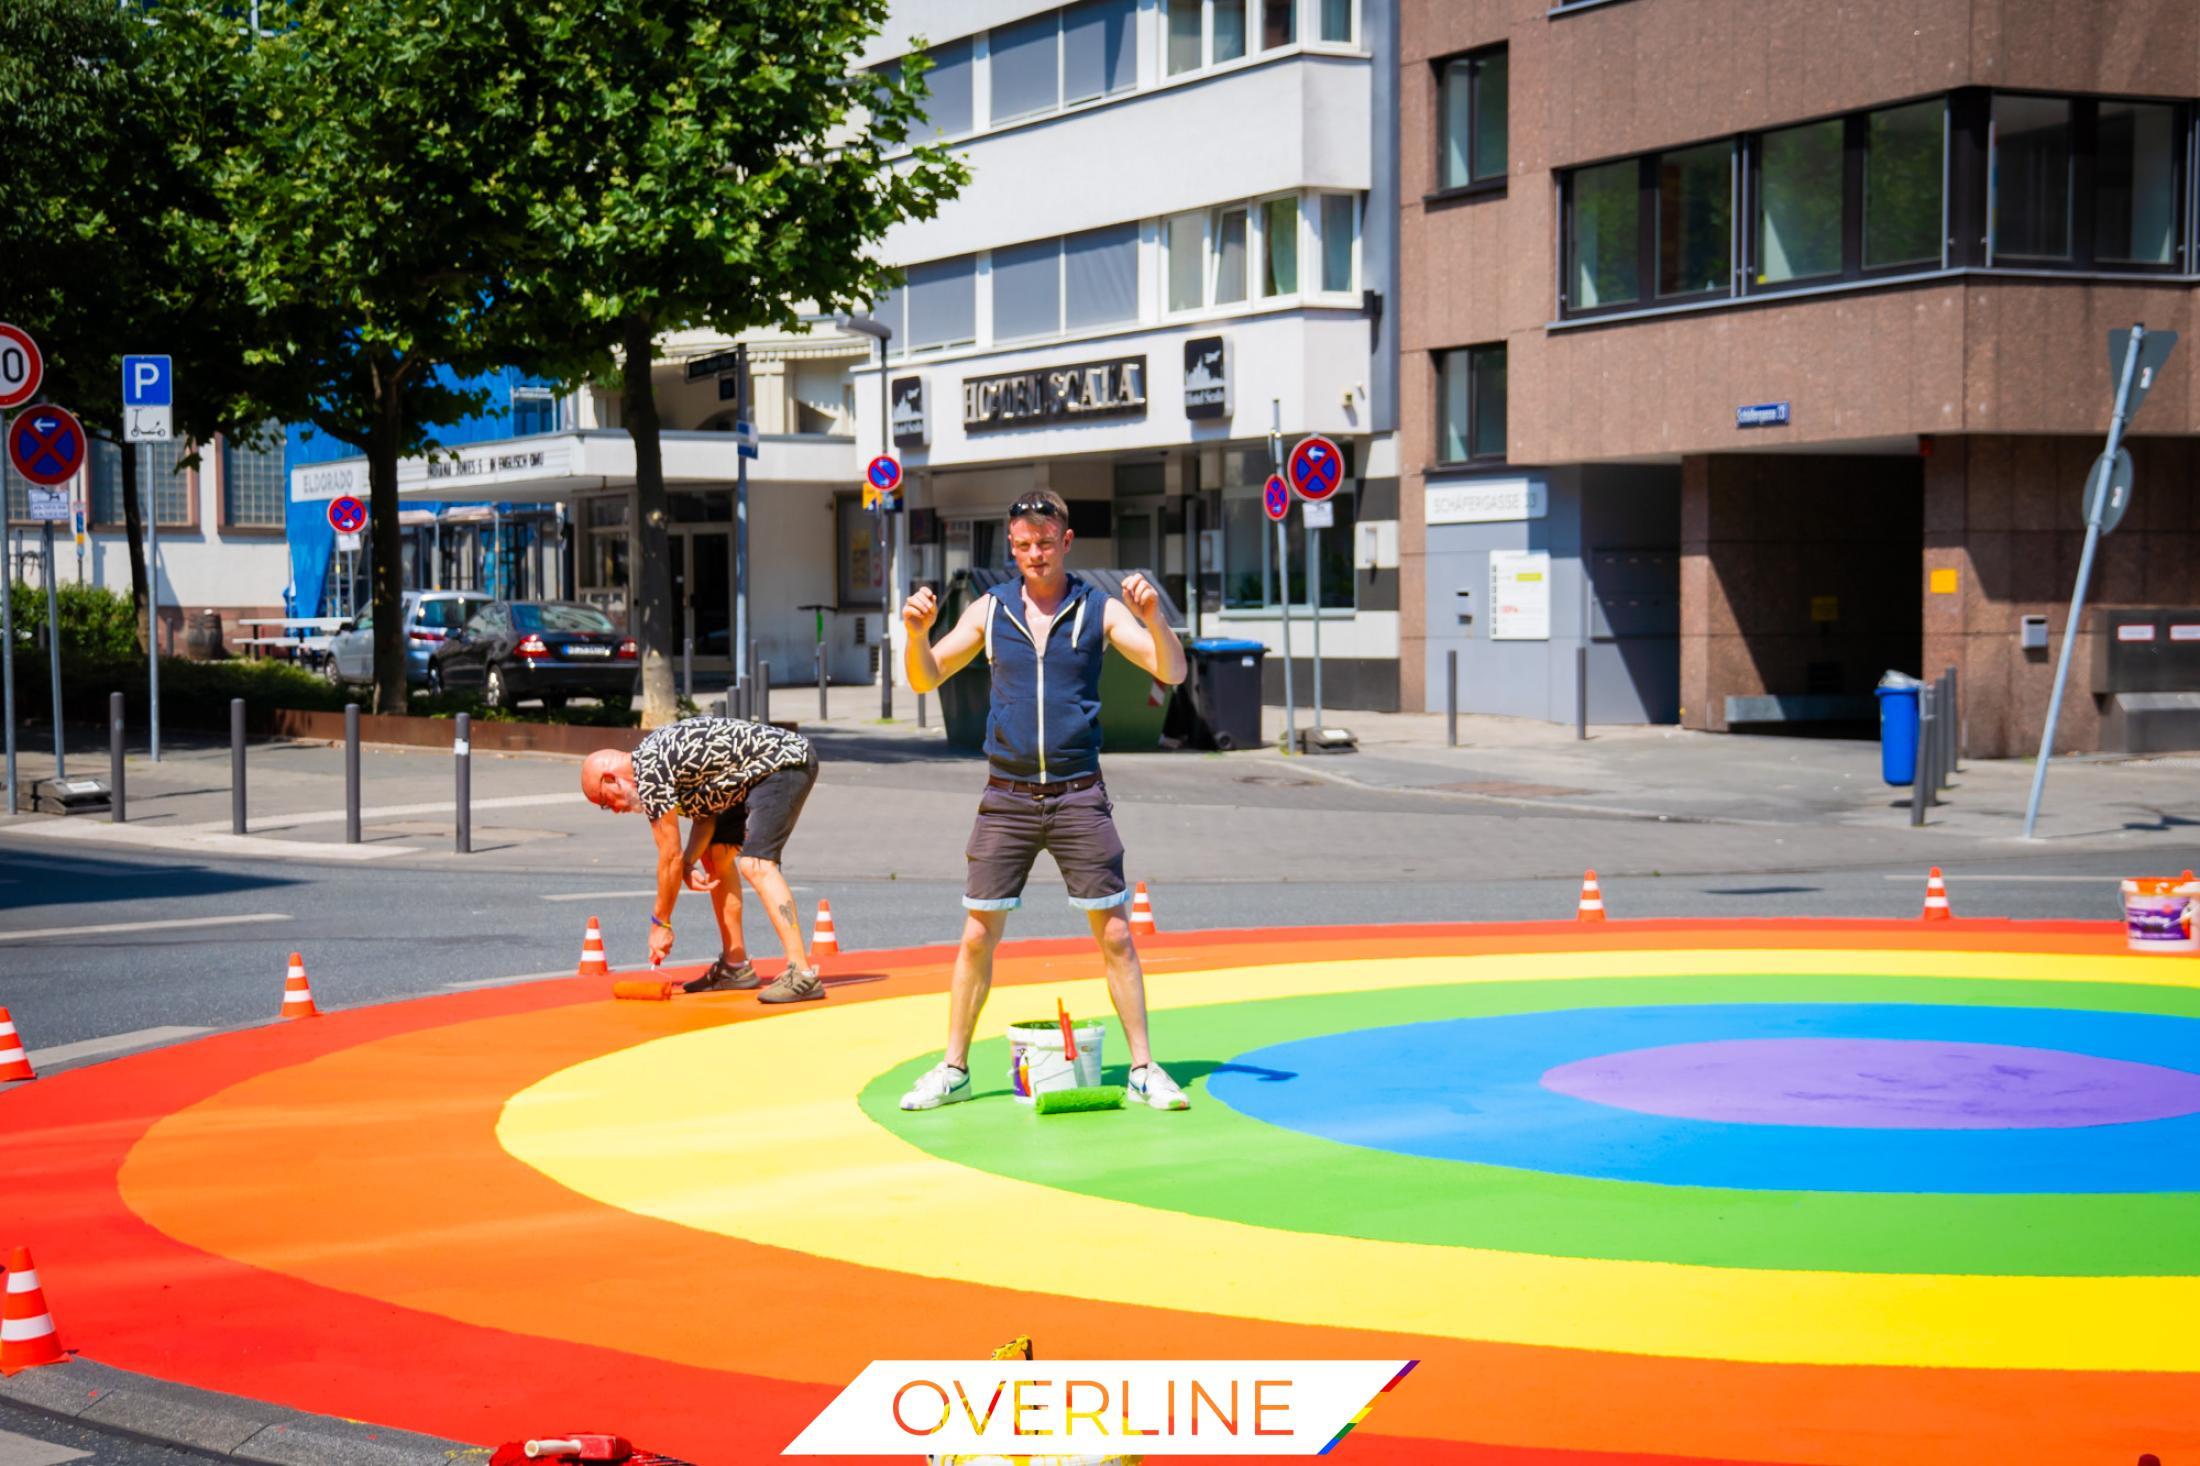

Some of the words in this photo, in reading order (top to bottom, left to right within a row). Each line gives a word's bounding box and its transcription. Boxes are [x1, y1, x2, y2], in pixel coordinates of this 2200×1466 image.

[0, 347, 24, 384] 0
[135, 363, 159, 399] P
[963, 374, 1042, 423] HOTEL
[1050, 363, 1146, 412] SCALA
[303, 470, 353, 494] ELDORADO
